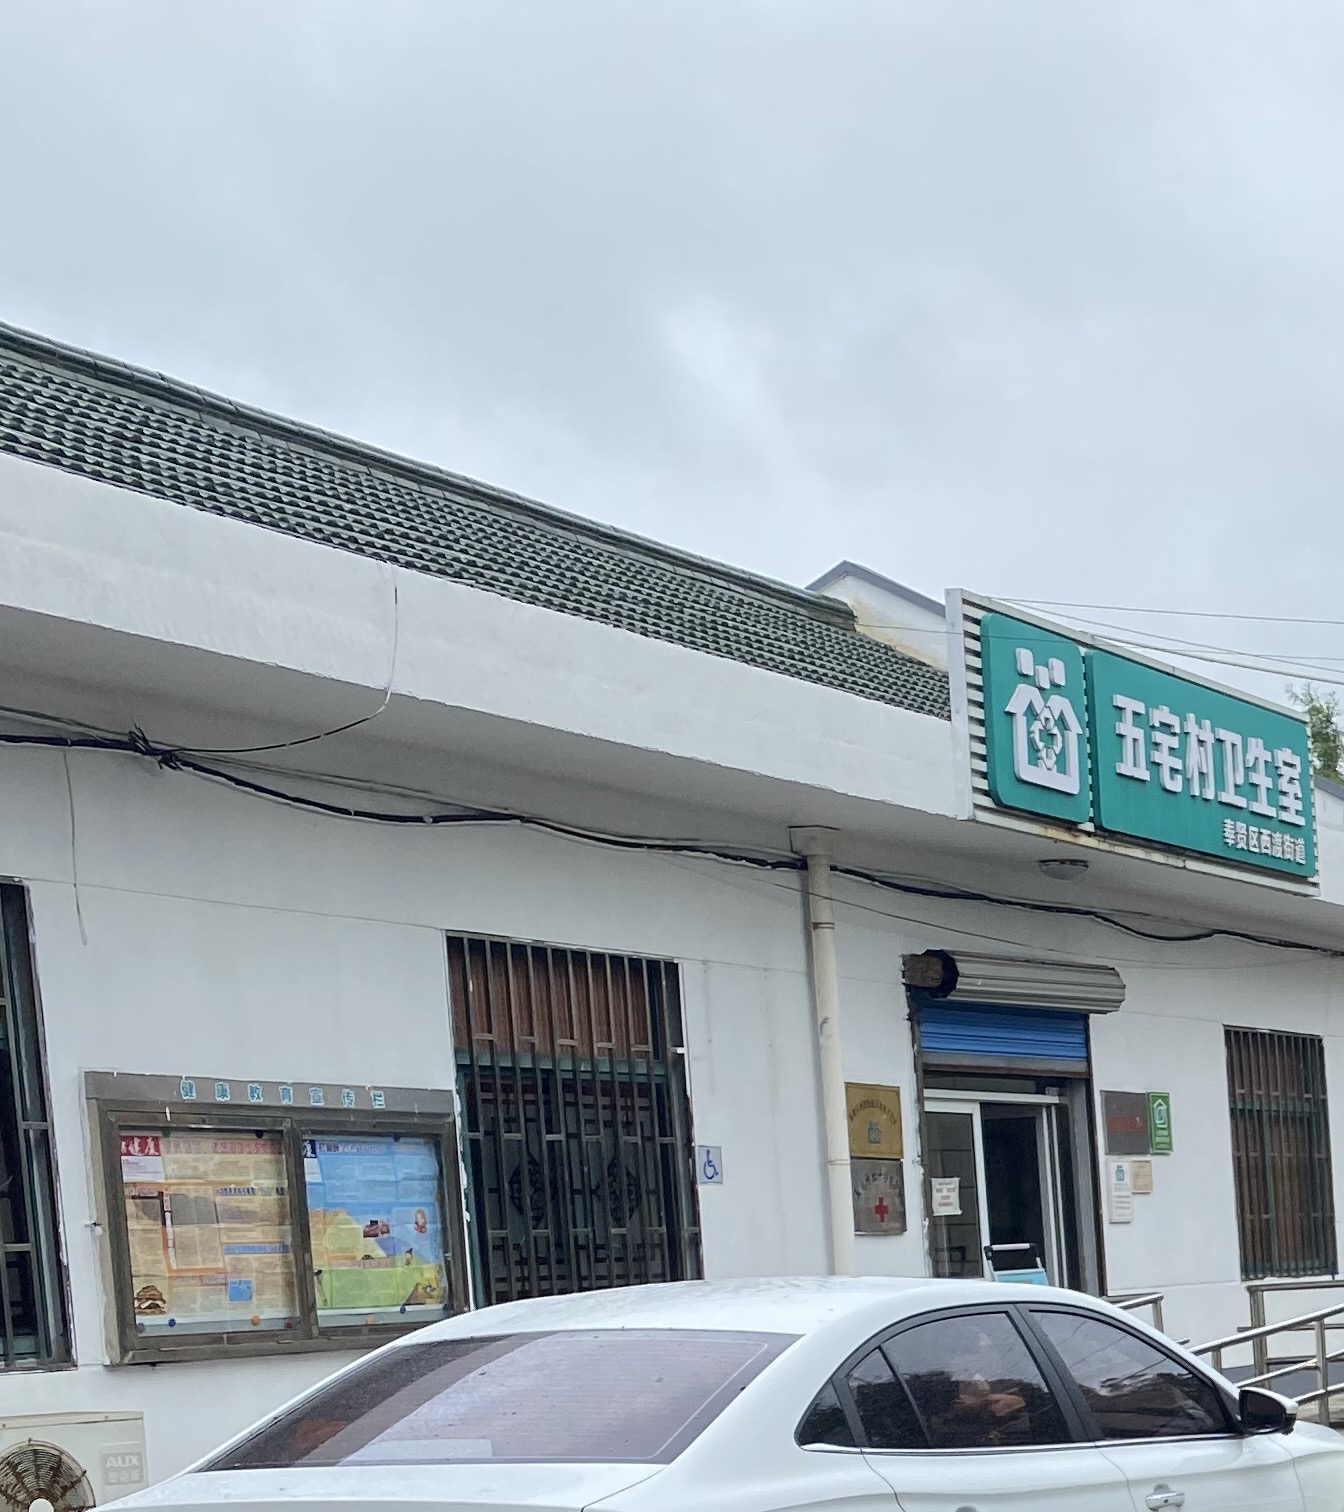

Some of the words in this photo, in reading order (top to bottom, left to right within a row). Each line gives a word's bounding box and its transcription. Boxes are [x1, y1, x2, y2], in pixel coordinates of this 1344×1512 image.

[1112, 694, 1306, 826] 五宅村卫生室
[1223, 817, 1306, 865] 奉贤区西渡街道
[180, 1079, 386, 1109] 健康教育宣传栏
[106, 1455, 140, 1469] AUX
